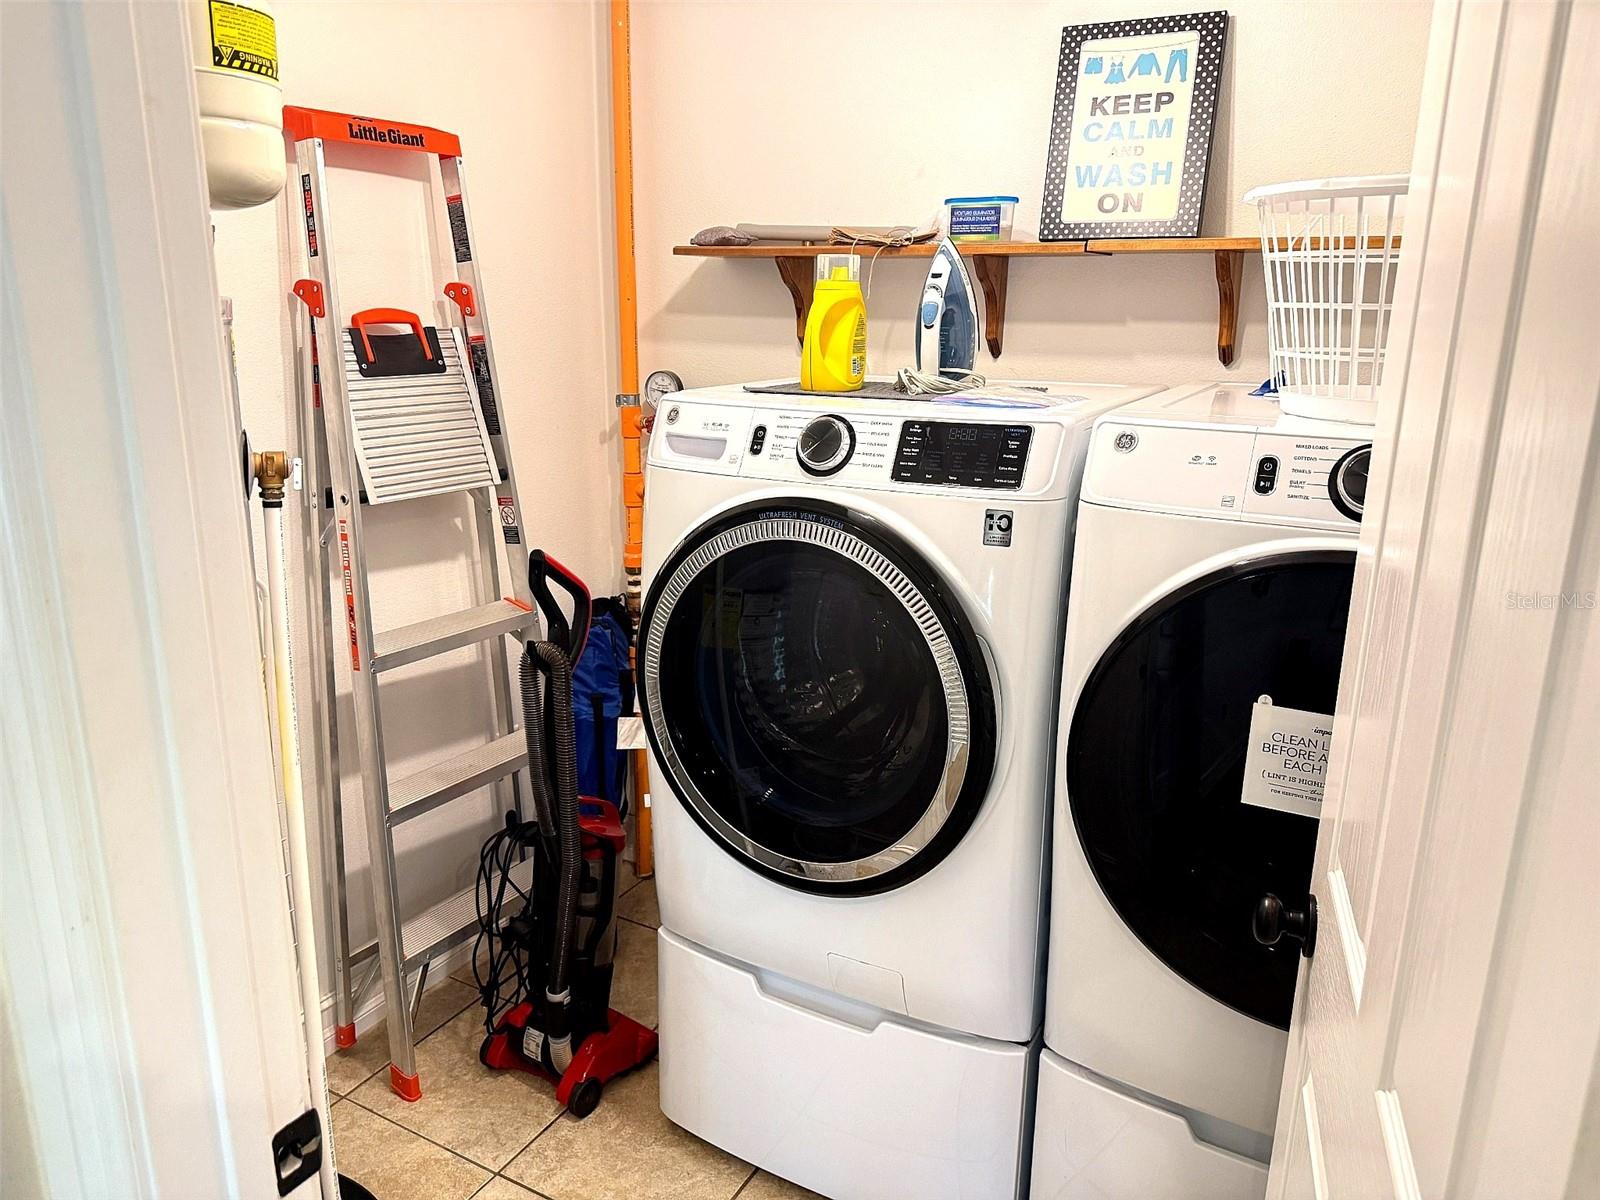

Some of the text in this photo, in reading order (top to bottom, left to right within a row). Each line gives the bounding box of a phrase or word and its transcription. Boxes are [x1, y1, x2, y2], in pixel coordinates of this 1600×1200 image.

[239, 52, 271, 67] WARNING
[1090, 92, 1174, 116] KEEP
[1083, 118, 1173, 142] CALM
[1108, 146, 1144, 158] AND
[1075, 161, 1172, 188] WASH
[1097, 193, 1143, 213] ON
[759, 511, 844, 530] ULTRAFRESH VENT SYSTEM
[341, 540, 349, 566] Little
[344, 570, 352, 595] Giant
[1272, 733, 1318, 749] CLEAN
[1262, 743, 1316, 761] BEFORE
[1267, 772, 1287, 780] LINT
[1284, 759, 1322, 775] EACH
